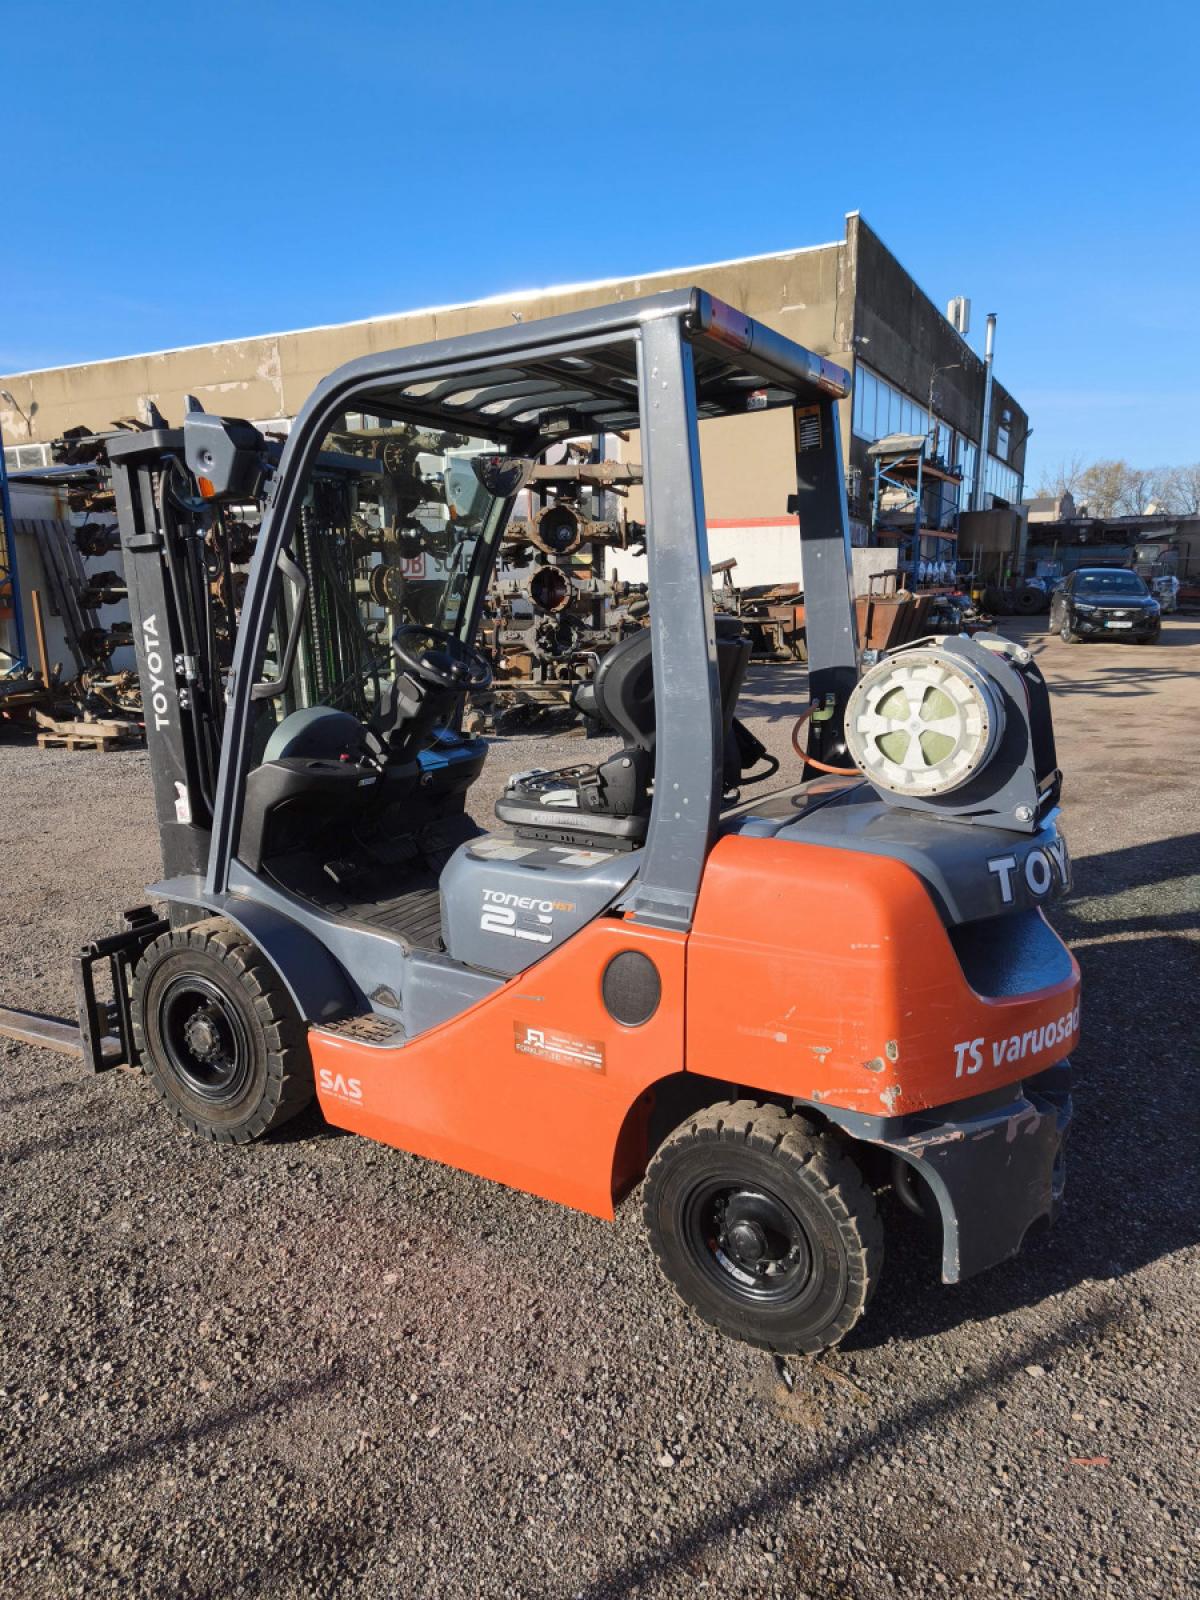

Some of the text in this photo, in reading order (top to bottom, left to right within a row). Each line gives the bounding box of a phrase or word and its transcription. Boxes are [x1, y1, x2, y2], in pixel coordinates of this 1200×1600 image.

[142, 614, 169, 731] TOYOTA
[987, 838, 1068, 903] TOY
[480, 903, 553, 944] 25
[482, 888, 553, 913] TONERO
[954, 992, 1080, 1078] TS varuosad
[319, 1068, 363, 1099] SAS
